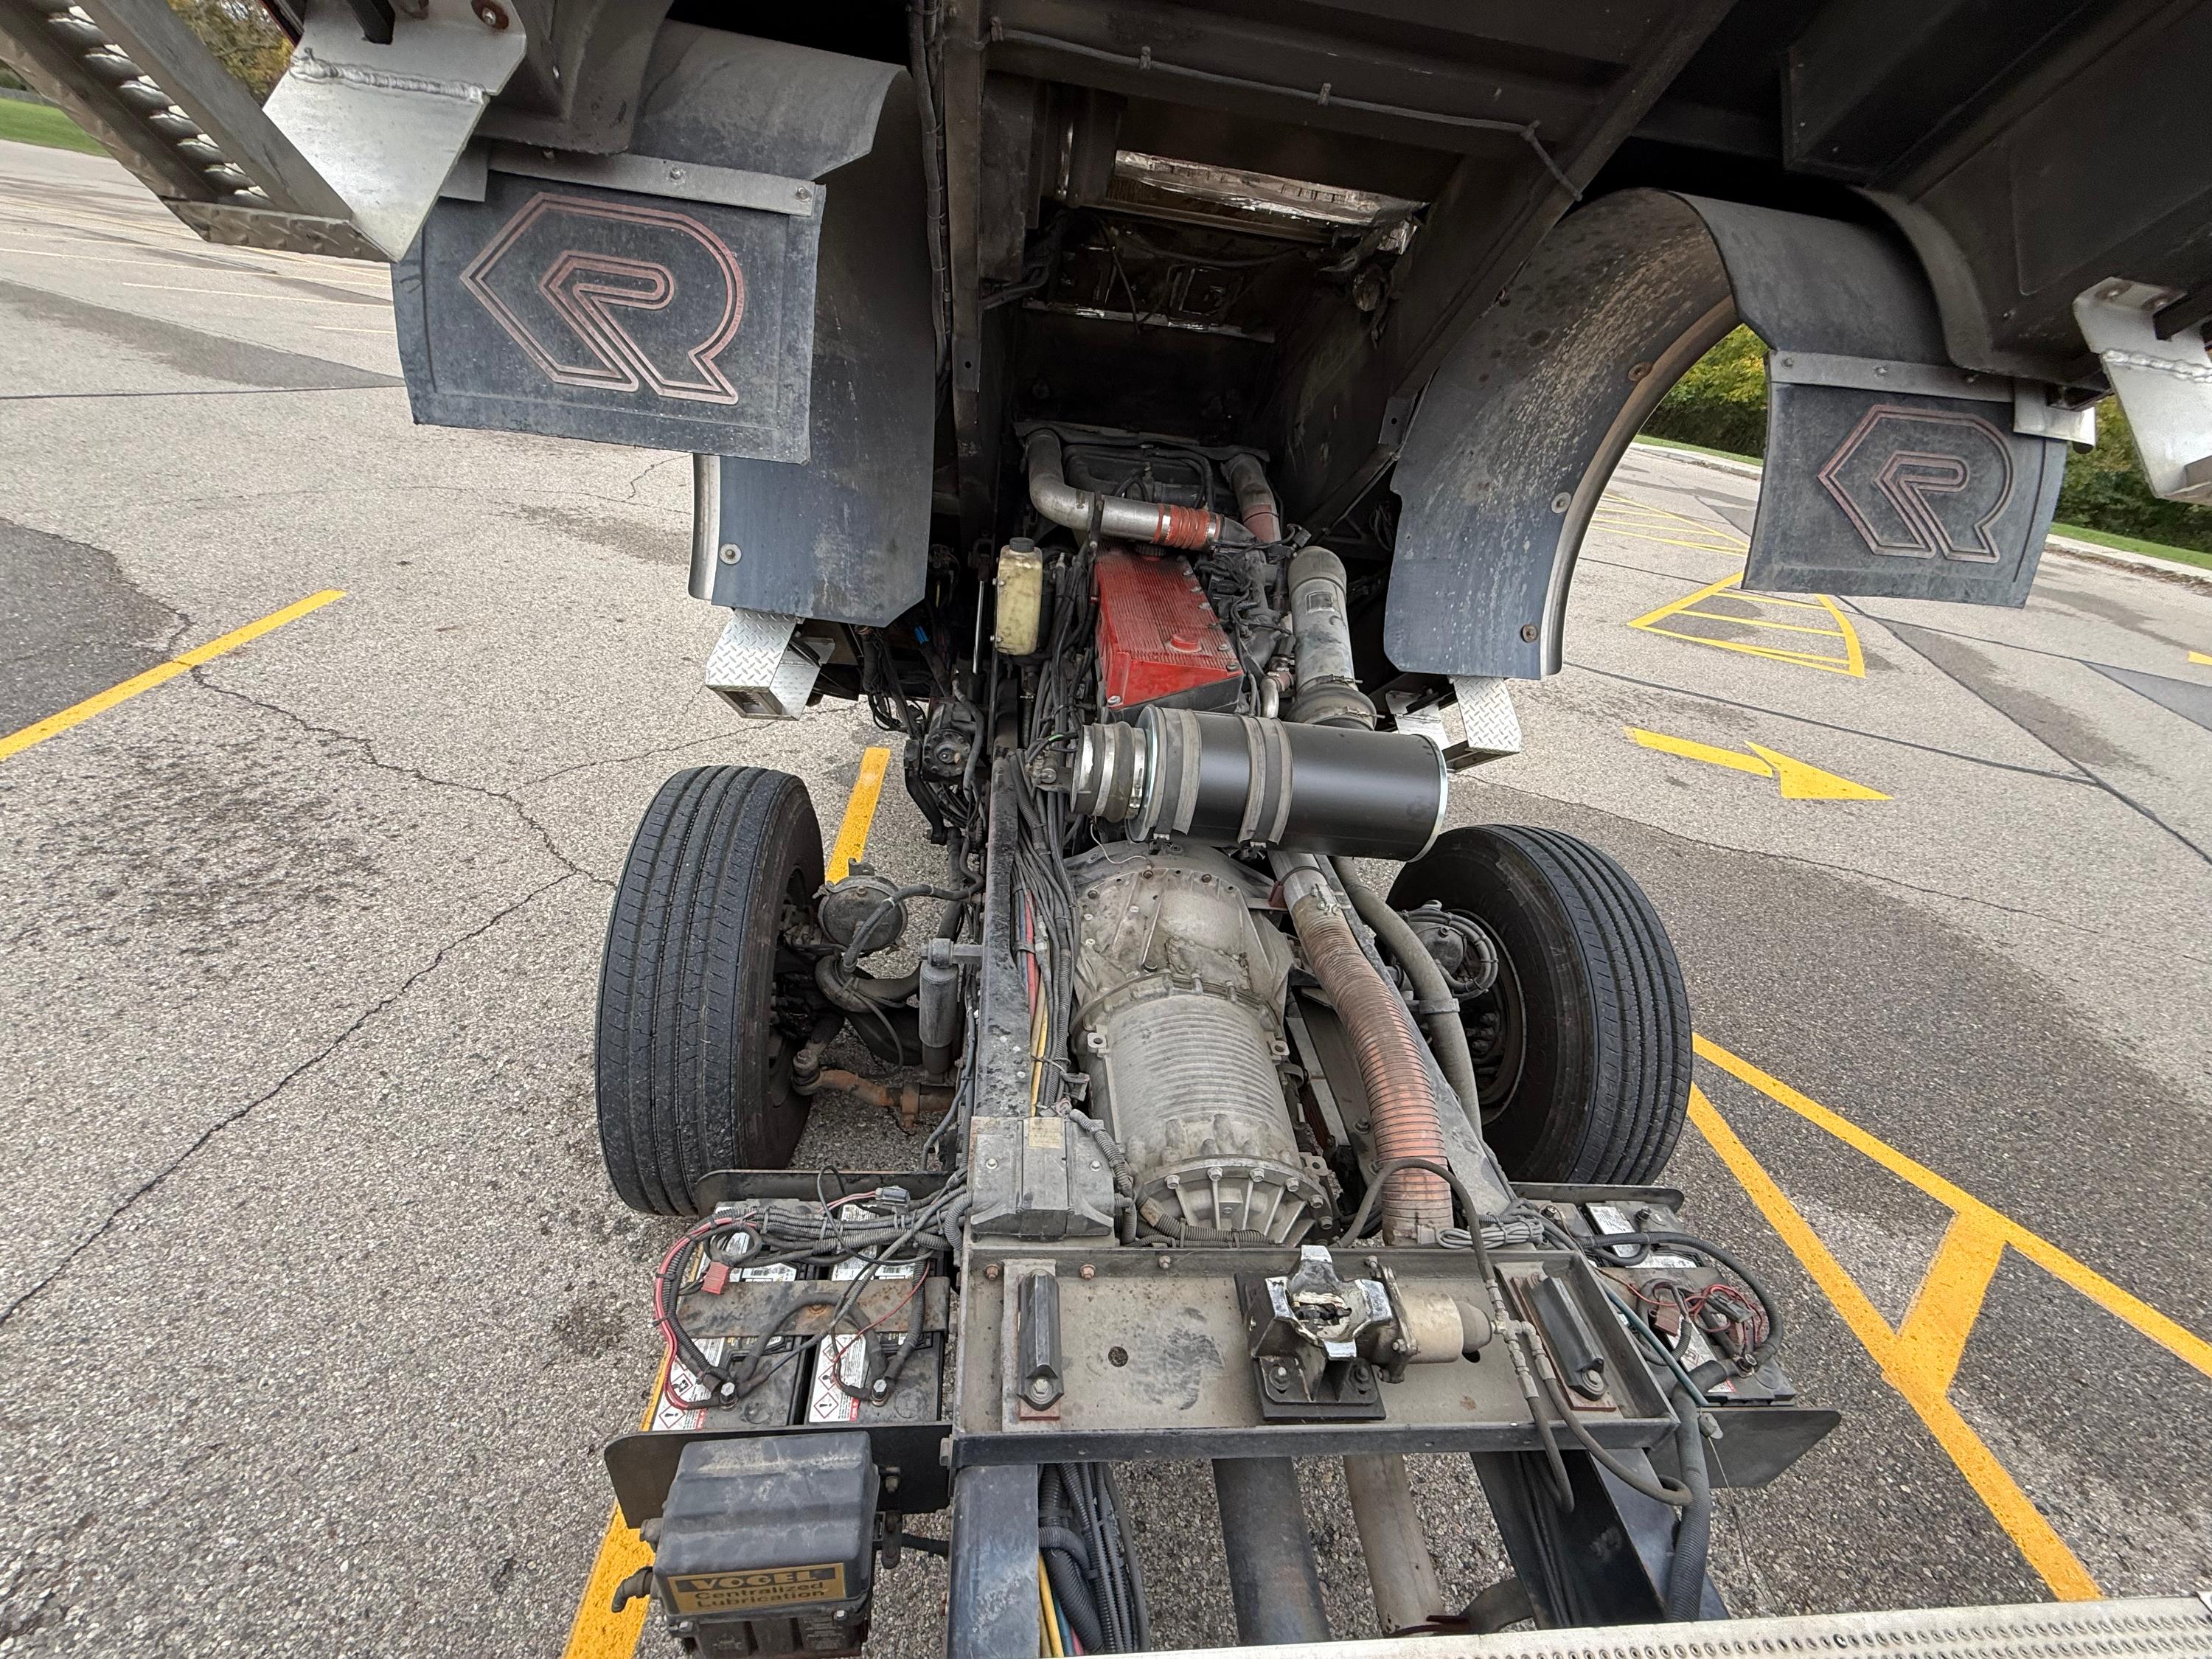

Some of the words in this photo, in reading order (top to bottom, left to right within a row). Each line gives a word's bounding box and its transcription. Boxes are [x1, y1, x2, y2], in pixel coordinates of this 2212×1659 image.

[690, 1571, 816, 1590] VOGEL
[695, 1582, 823, 1599] Centralized
[697, 1590, 825, 1607] Lubrication
